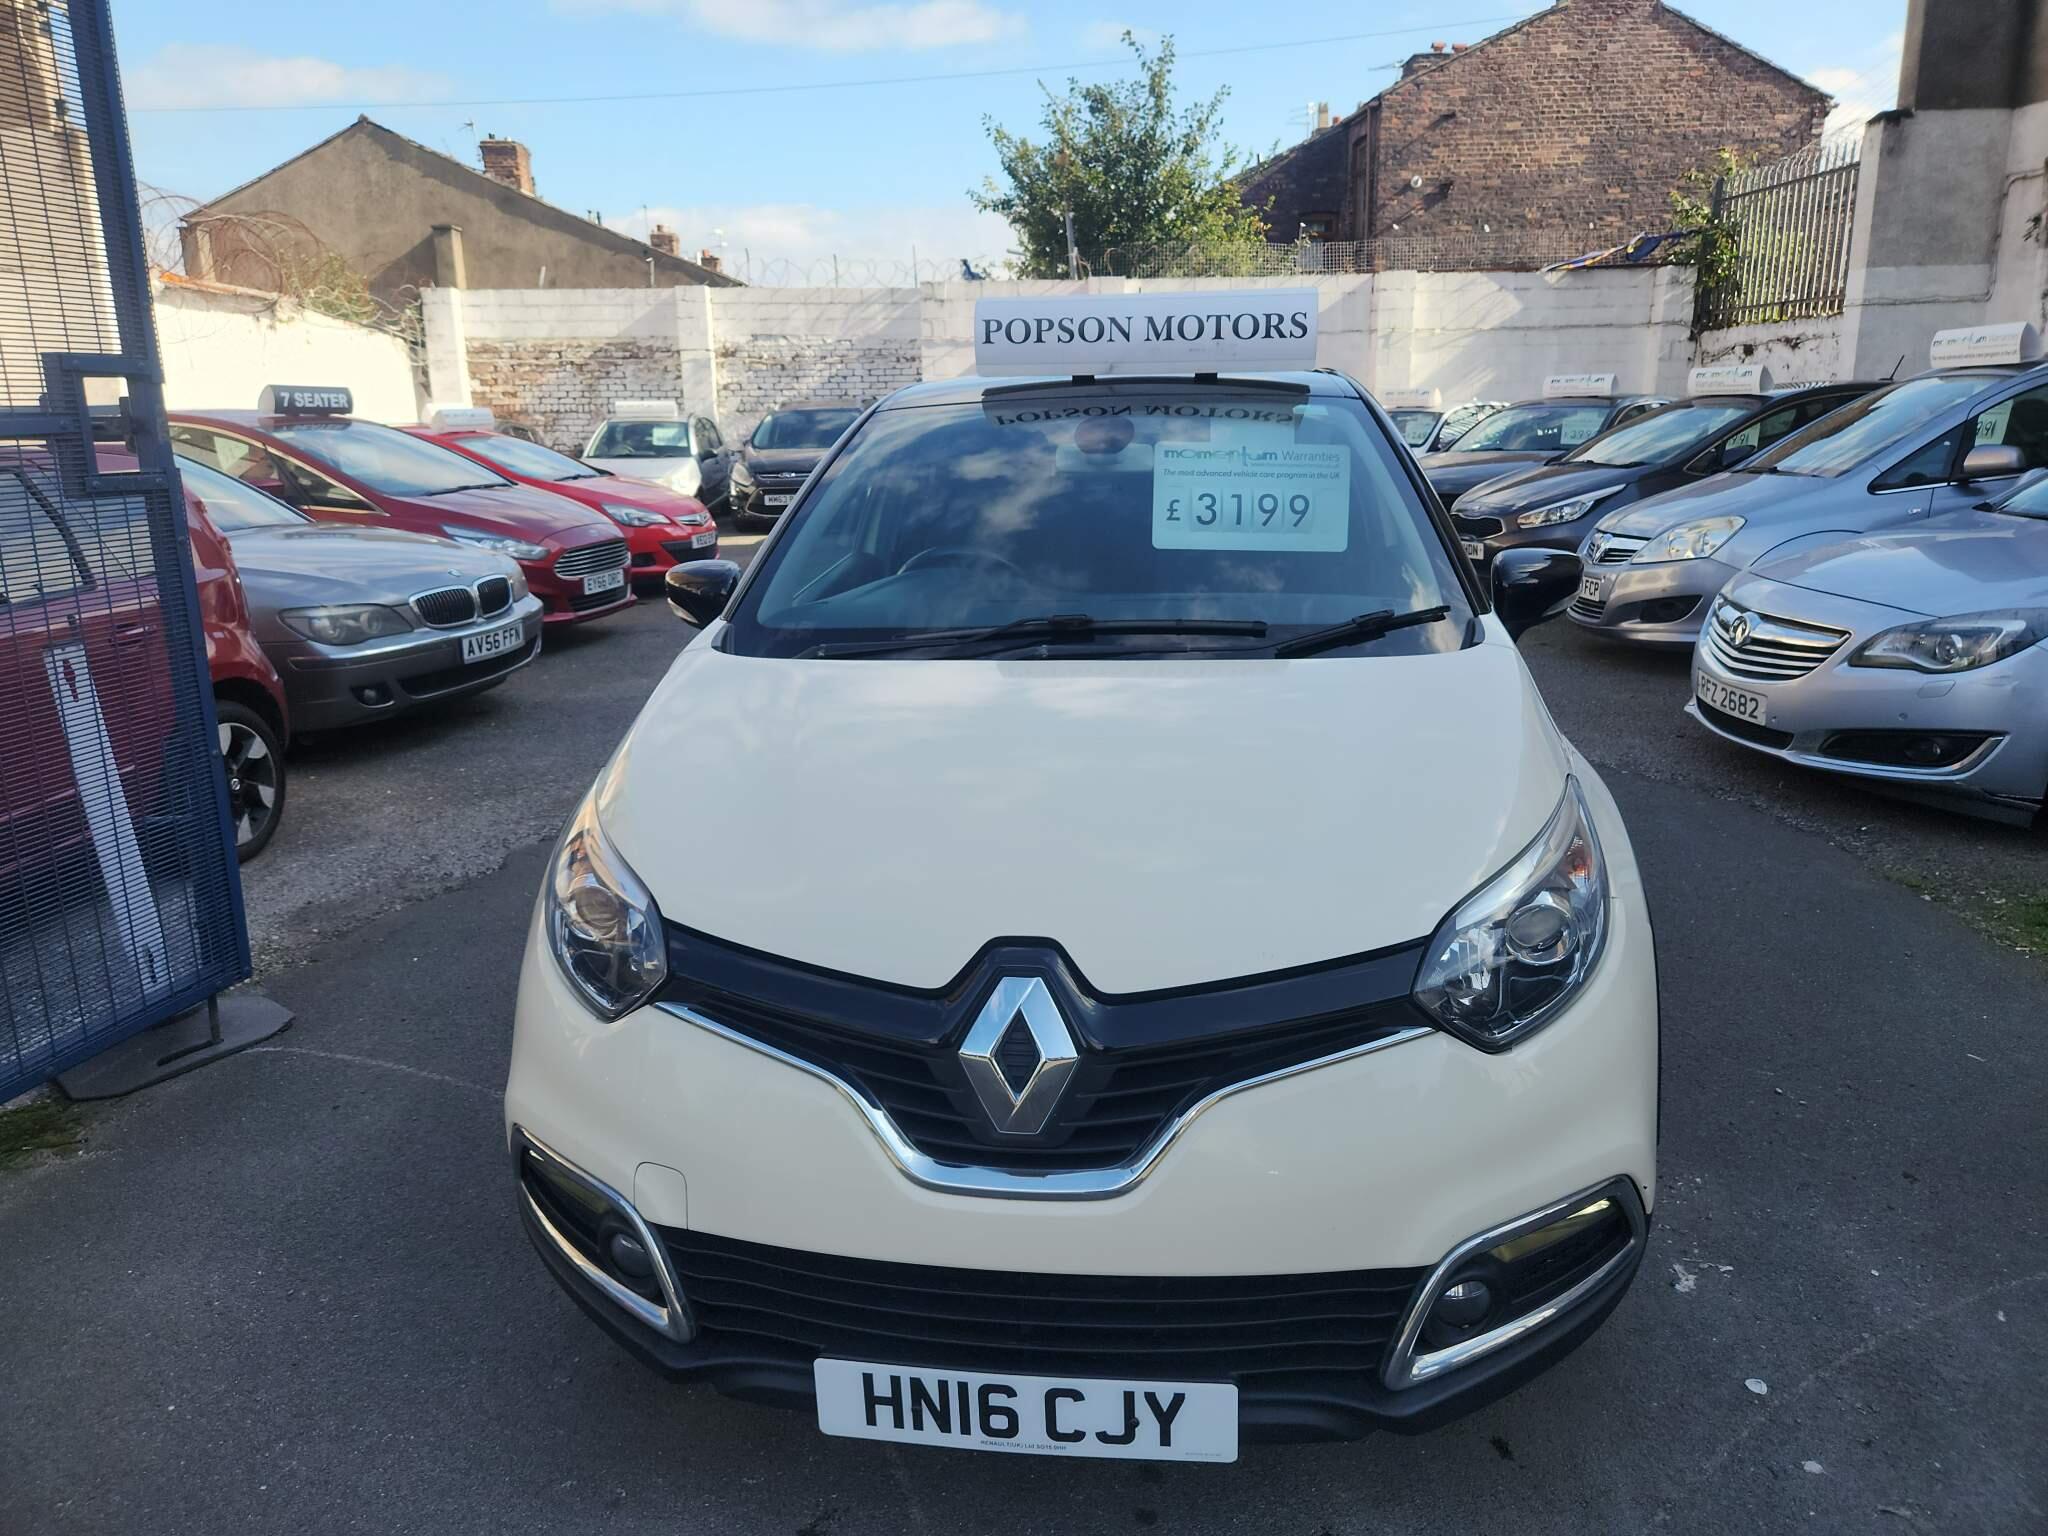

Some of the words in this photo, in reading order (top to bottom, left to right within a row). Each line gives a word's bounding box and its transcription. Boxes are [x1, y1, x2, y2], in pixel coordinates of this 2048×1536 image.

[981, 315, 1134, 345] POPSON
[1144, 311, 1308, 342] MOTORS
[280, 392, 290, 407] 7
[293, 392, 349, 408] SEATER
[1163, 446, 1278, 466] momentum
[1281, 449, 1341, 464] Warranties
[1163, 468, 1177, 476] The
[1196, 470, 1232, 478] advanced
[1233, 470, 1258, 478] vehicle
[1276, 472, 1308, 481] program
[1165, 499, 1181, 521] £
[1196, 493, 1311, 528] 3199
[1584, 579, 1600, 597] FCP
[468, 632, 500, 657] AV56
[502, 627, 521, 647] FFN
[1700, 675, 1718, 704] RFZ
[1720, 687, 1759, 720] 2682
[862, 1372, 1019, 1440] HN16
[1044, 1387, 1186, 1448] CJY
